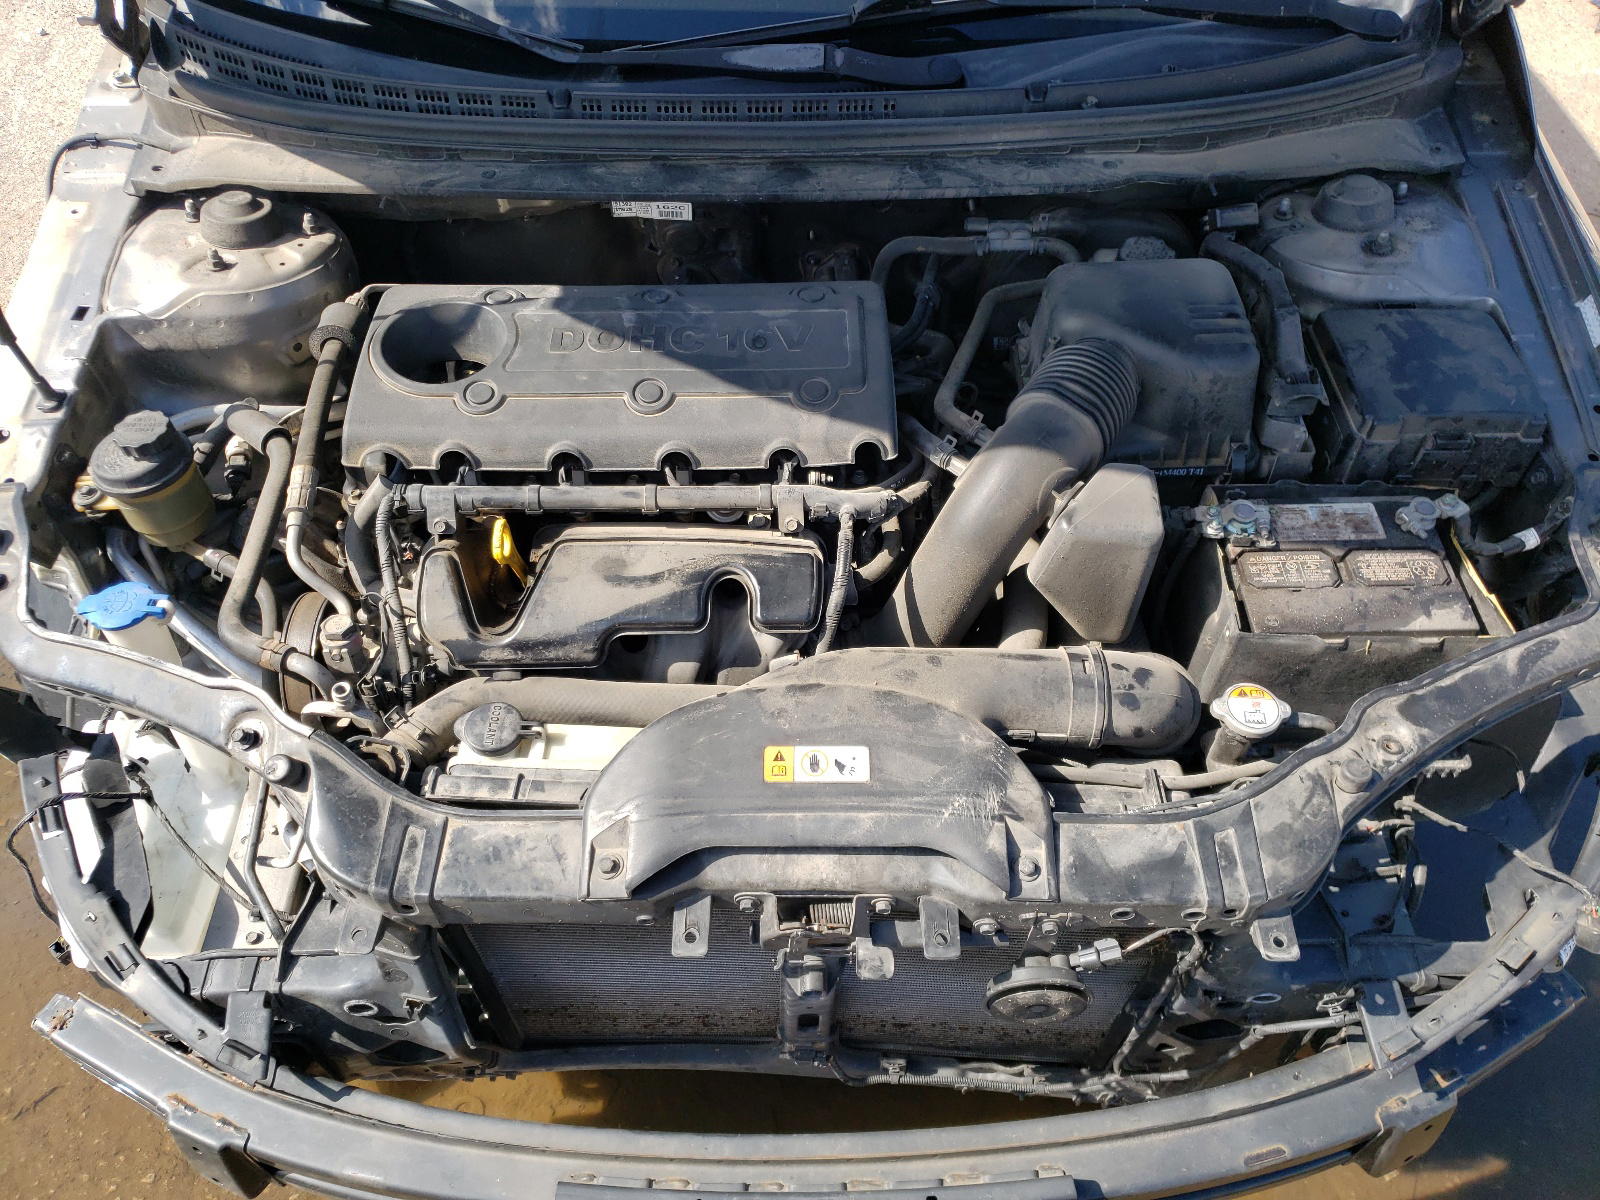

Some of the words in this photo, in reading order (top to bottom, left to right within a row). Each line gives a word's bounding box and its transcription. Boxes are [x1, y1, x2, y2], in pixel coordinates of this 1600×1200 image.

[548, 325, 705, 353] DOHC
[716, 325, 815, 352] 16V
[484, 705, 502, 746] COOLANT
